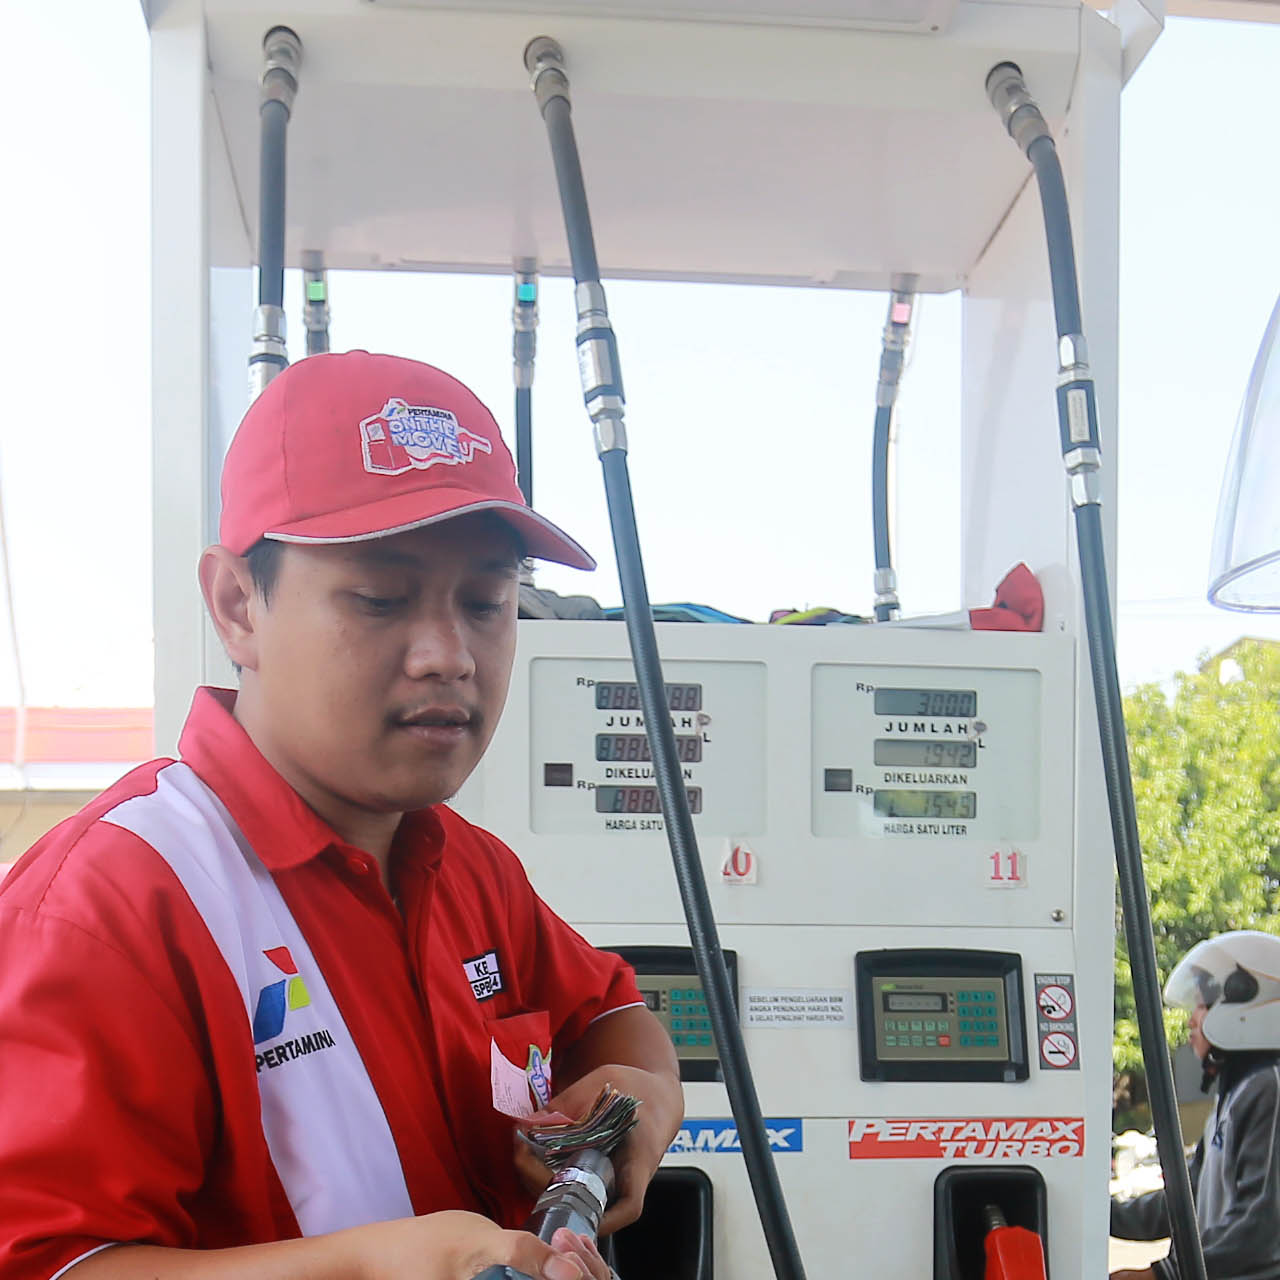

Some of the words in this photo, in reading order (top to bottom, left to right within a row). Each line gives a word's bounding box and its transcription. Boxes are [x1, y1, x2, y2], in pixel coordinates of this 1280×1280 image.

[407, 408, 454, 420] PERTAMINA
[392, 431, 463, 459] MOVE
[577, 677, 595, 687] Rp
[856, 682, 874, 693] Rp
[885, 722, 968, 734] JUMLAH
[703, 732, 711, 742] L
[978, 738, 985, 749] L
[884, 772, 968, 784] DIKELUARKAN
[577, 780, 595, 790] Rp
[855, 784, 874, 795] Rp
[606, 820, 637, 830] HARGA
[640, 820, 663, 830] SATU
[884, 823, 914, 834] HARGA
[917, 824, 940, 835] SATU
[942, 825, 967, 836] LITER
[990, 852, 1020, 880] 11
[256, 1029, 336, 1073] PERTAMINA
[849, 1119, 1083, 1142] PERTAMAX
[940, 1140, 1080, 1159] TURBO
